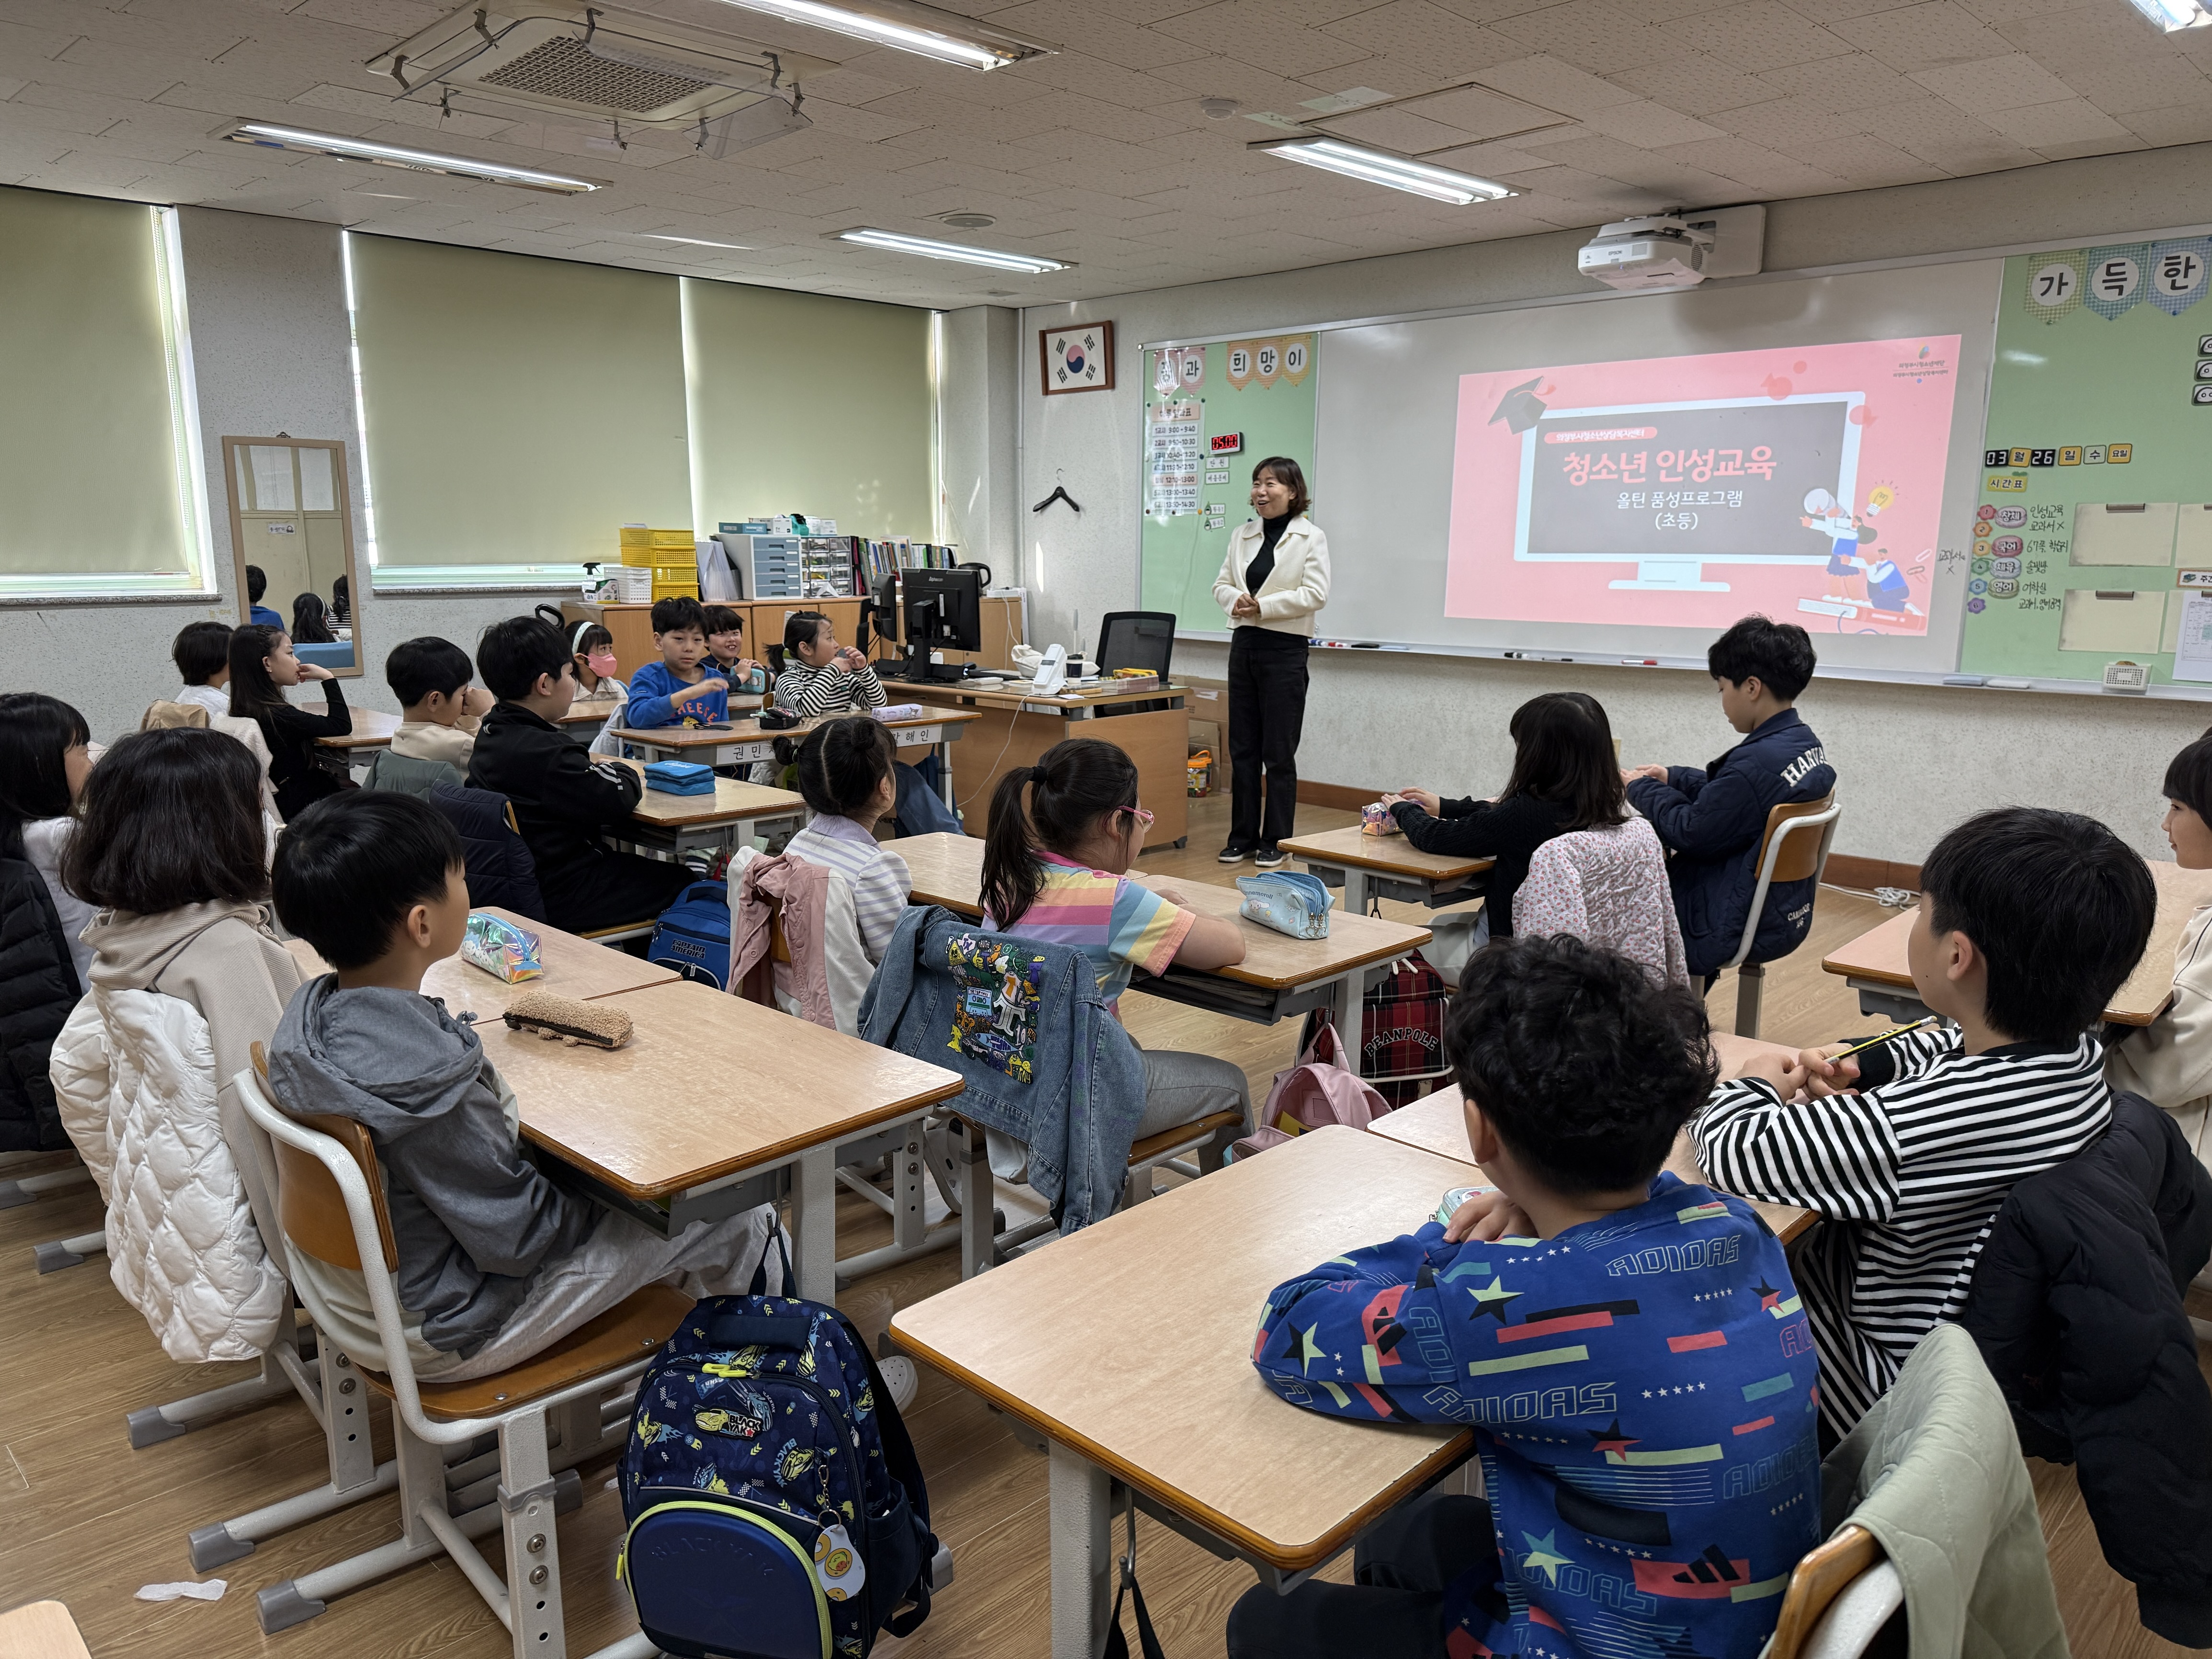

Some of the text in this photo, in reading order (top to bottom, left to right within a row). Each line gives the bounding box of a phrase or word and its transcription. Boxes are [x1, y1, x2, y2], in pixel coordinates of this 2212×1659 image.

[2040, 255, 2196, 296] 가득한
[1233, 349, 1301, 374] 희망이
[1986, 449, 2127, 465] 03 월 26 일 수 요일
[1563, 446, 1777, 486] 청소년 인성교육
[1990, 479, 2023, 489] 시간표
[1617, 490, 1743, 509] 올틴 품성프로그램
[2001, 510, 2021, 522] 창체
[2030, 504, 2064, 519] 인성교육
[1655, 512, 1698, 530] (초등)
[2029, 520, 2055, 533] 교과서
[1999, 542, 2017, 553] 국어
[1994, 581, 2013, 592] 영어
[671, 703, 718, 725] HEESE
[671, 944, 706, 960] AMERICA
[673, 939, 707, 953] CAPTAIN
[963, 938, 973, 951] TX
[1365, 1027, 1439, 1057] BEANPOLE
[1605, 1234, 1741, 1277] ADIDAS
[729, 1414, 762, 1432] BLACK
[729, 1423, 746, 1436] YAK
[773, 1438, 798, 1488] BLACKYAK
[1506, 1546, 1658, 1617] DIDAS
